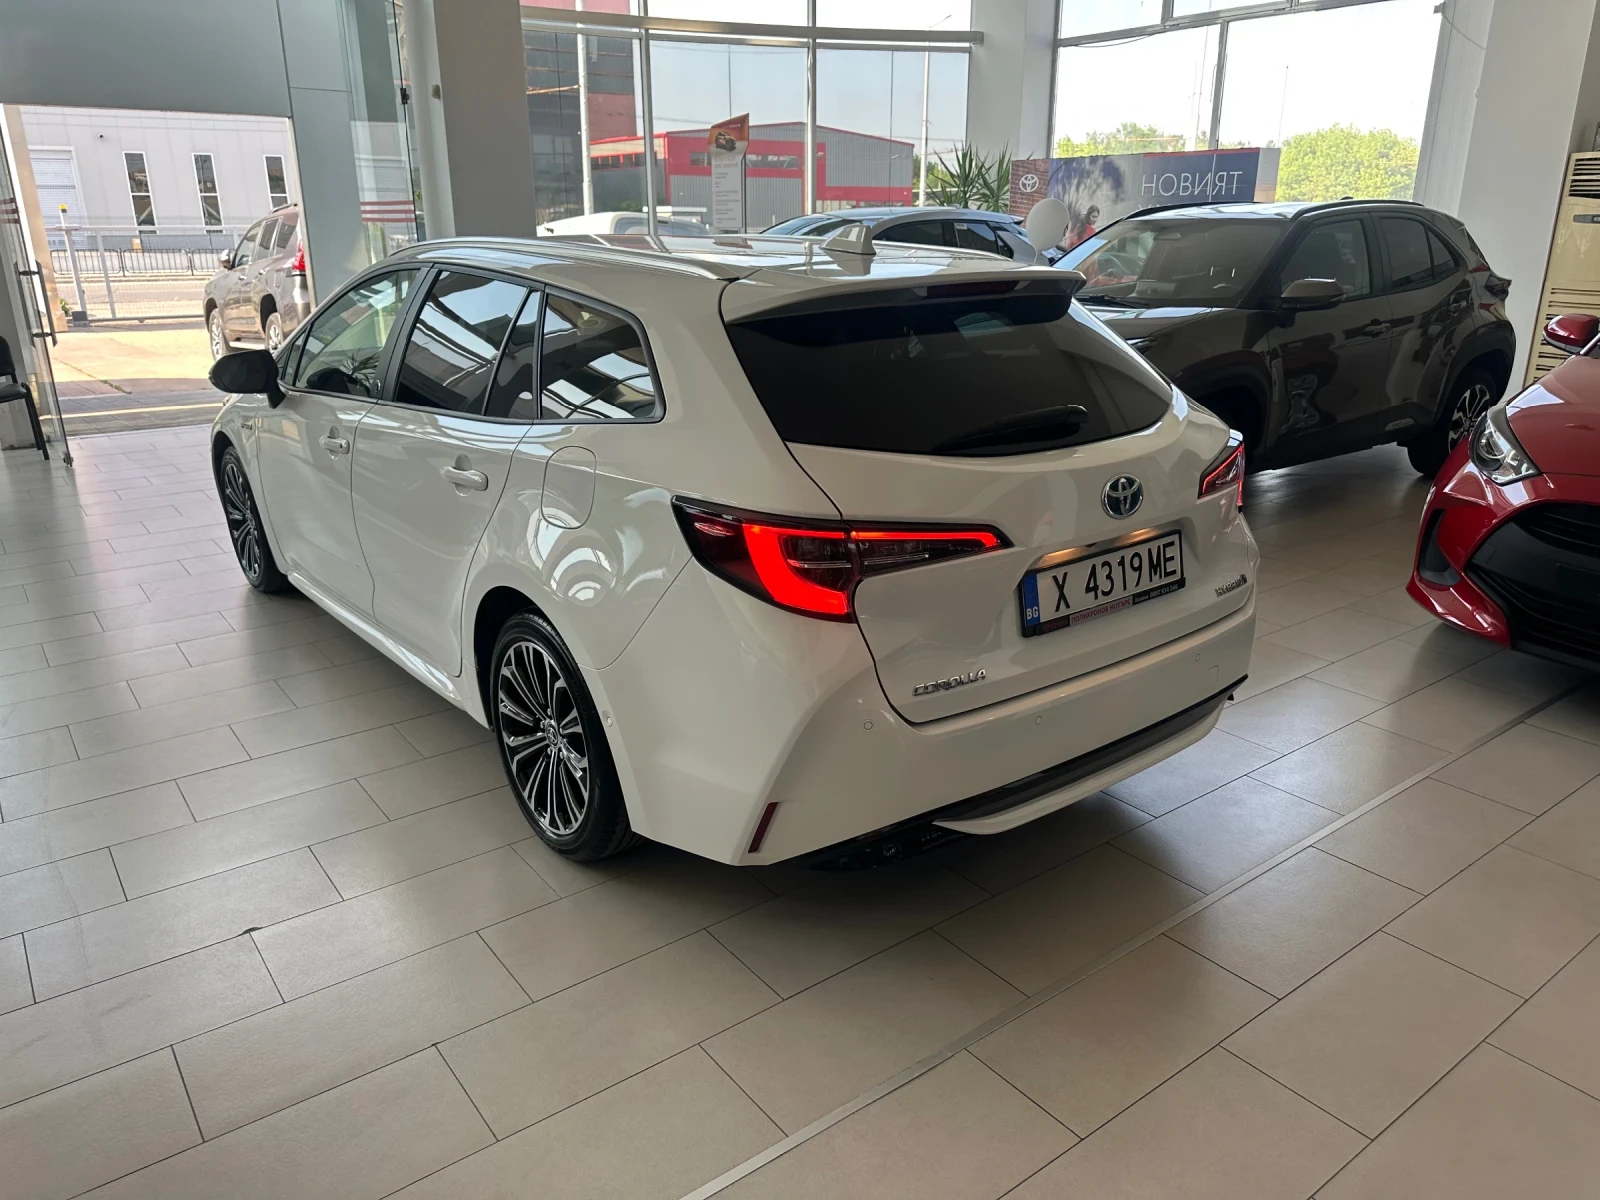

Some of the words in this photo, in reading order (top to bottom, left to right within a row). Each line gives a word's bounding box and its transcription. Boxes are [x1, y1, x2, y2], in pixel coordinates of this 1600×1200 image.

[1141, 171, 1243, 196] НОВИЯТ
[1052, 571, 1071, 612] X
[1084, 551, 1143, 600] 4319
[1147, 540, 1177, 583] ME
[1026, 606, 1039, 620] BG
[912, 668, 986, 697] COROLLA
